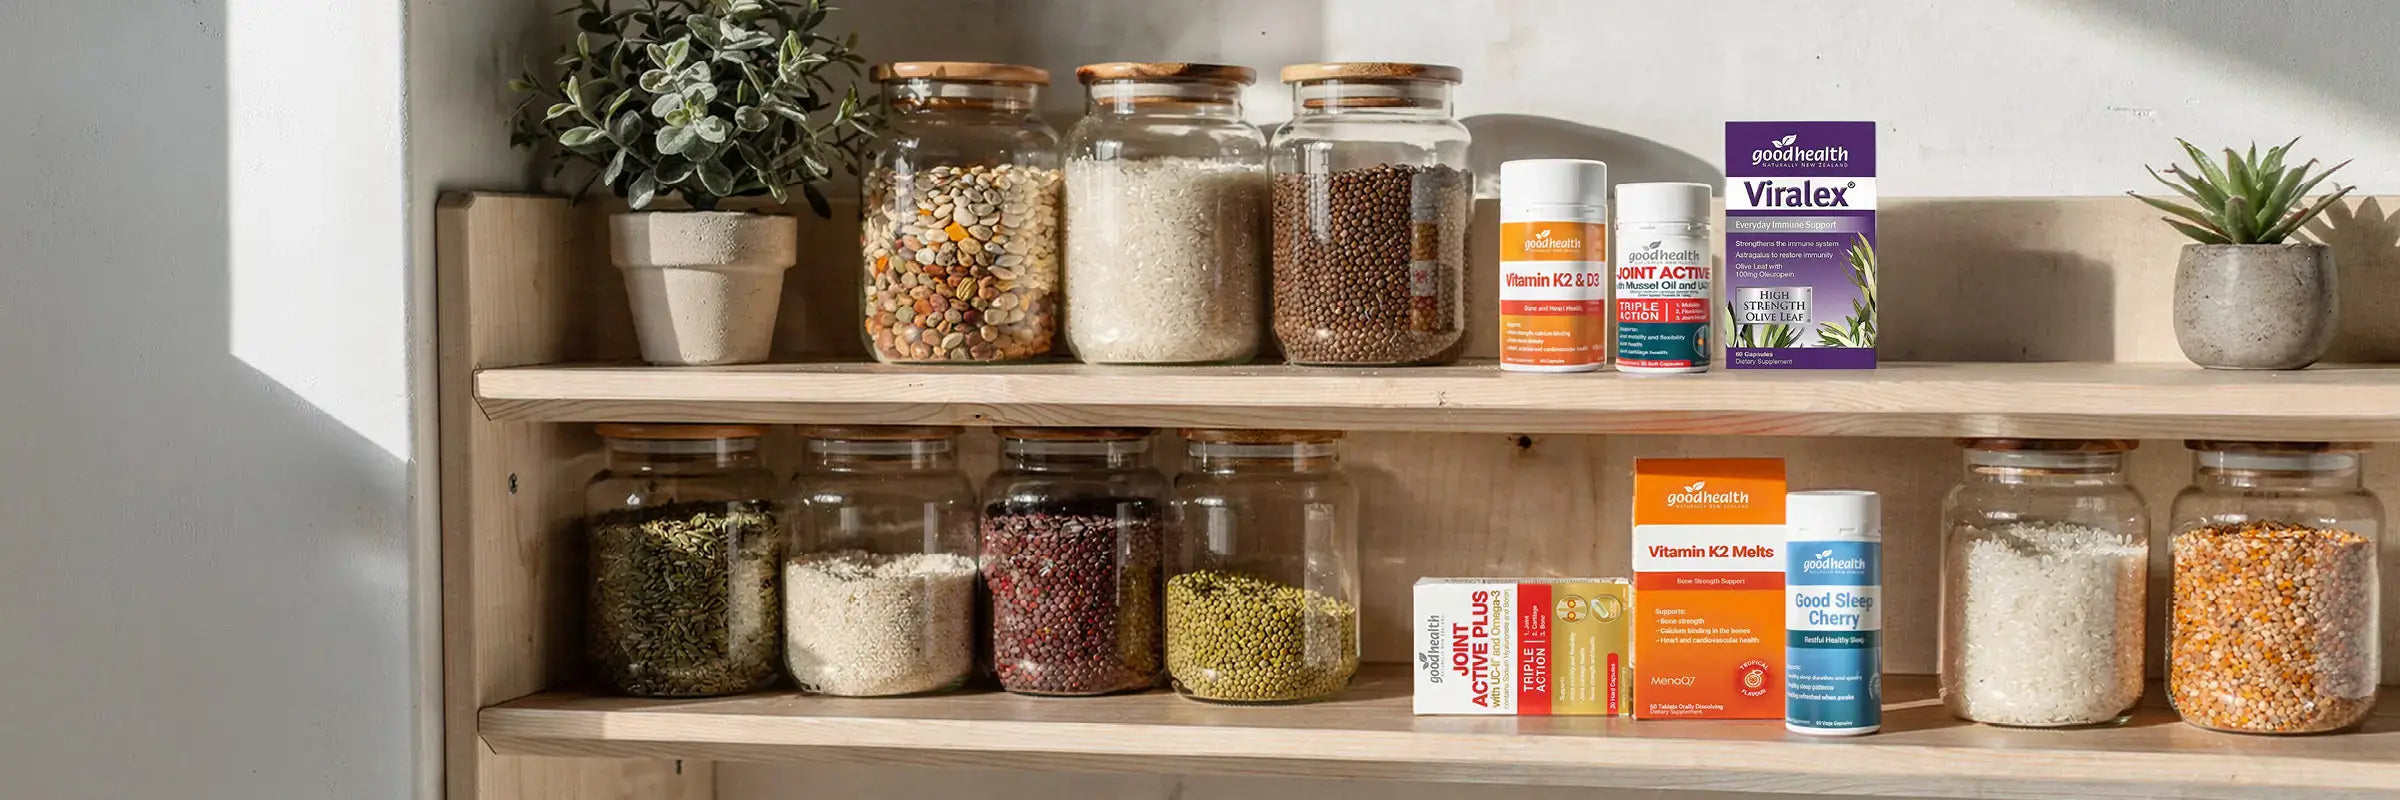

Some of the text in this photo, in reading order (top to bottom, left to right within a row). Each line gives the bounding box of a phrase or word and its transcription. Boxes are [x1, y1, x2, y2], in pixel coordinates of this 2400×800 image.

[1752, 146, 1848, 165] goodhealth
[1735, 221, 1837, 231] Everyday Immune Support
[1505, 272, 1600, 287] Vitamin K2 & D3
[1617, 266, 1711, 280] JOINT ACTIVE
[1626, 281, 1658, 290] Mussel
[1661, 281, 1676, 290] Oil
[1678, 281, 1697, 290] and
[1760, 291, 1789, 300] HIGH
[1620, 302, 1659, 311] TRIPLE
[1743, 301, 1805, 311] STRENGTH
[1745, 312, 1804, 321] OLIVE LEAF
[1667, 491, 1749, 507] goodhealth
[1648, 545, 1774, 558] Vitamin K2 Melts
[1796, 592, 1873, 612] Good Sleep
[1491, 590, 1502, 636] Omega-3
[1809, 610, 1860, 630] Cherry
[1687, 627, 1711, 635] binding
[1491, 638, 1501, 656] and
[1825, 636, 1849, 644] Healthy
[1453, 623, 1469, 676] JOINT
[1472, 591, 1488, 707] ACTIVE PLUS
[1523, 648, 1534, 692] TRIPLE
[1536, 648, 1546, 692] ACTION
[1740, 660, 1768, 671] TROPICAL
[1651, 676, 1696, 686] MenaQ7
[1490, 687, 1501, 708] with
[1741, 688, 1767, 697] FLAVOUR
